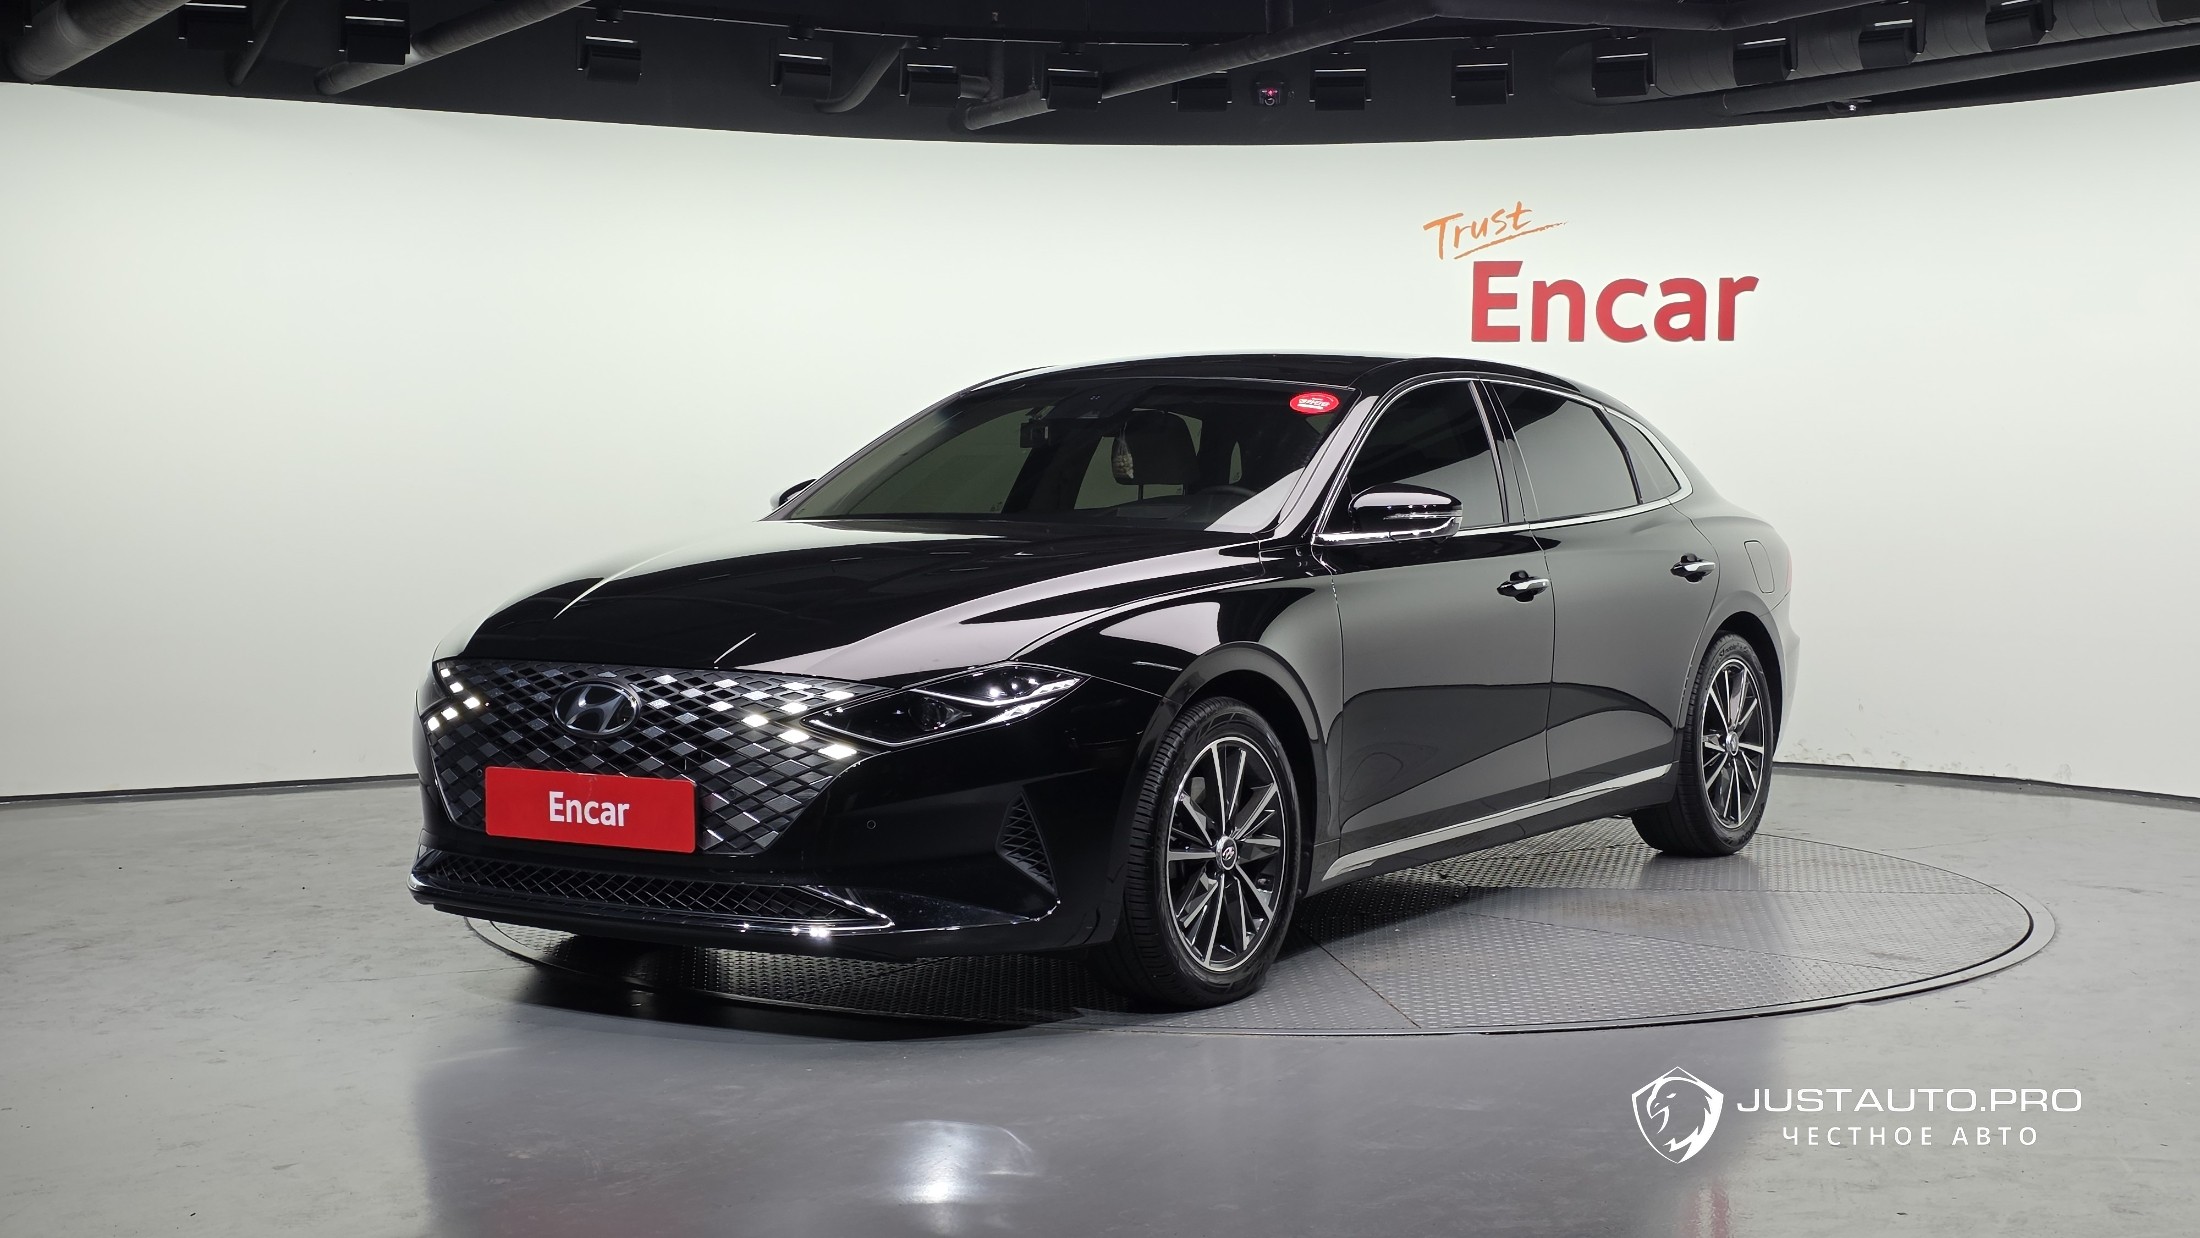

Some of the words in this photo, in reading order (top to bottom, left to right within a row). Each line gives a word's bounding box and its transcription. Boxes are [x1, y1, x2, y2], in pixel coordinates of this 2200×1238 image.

[1423, 201, 1533, 260] Trust
[1471, 260, 1760, 343] Encar
[549, 791, 630, 827] Encar
